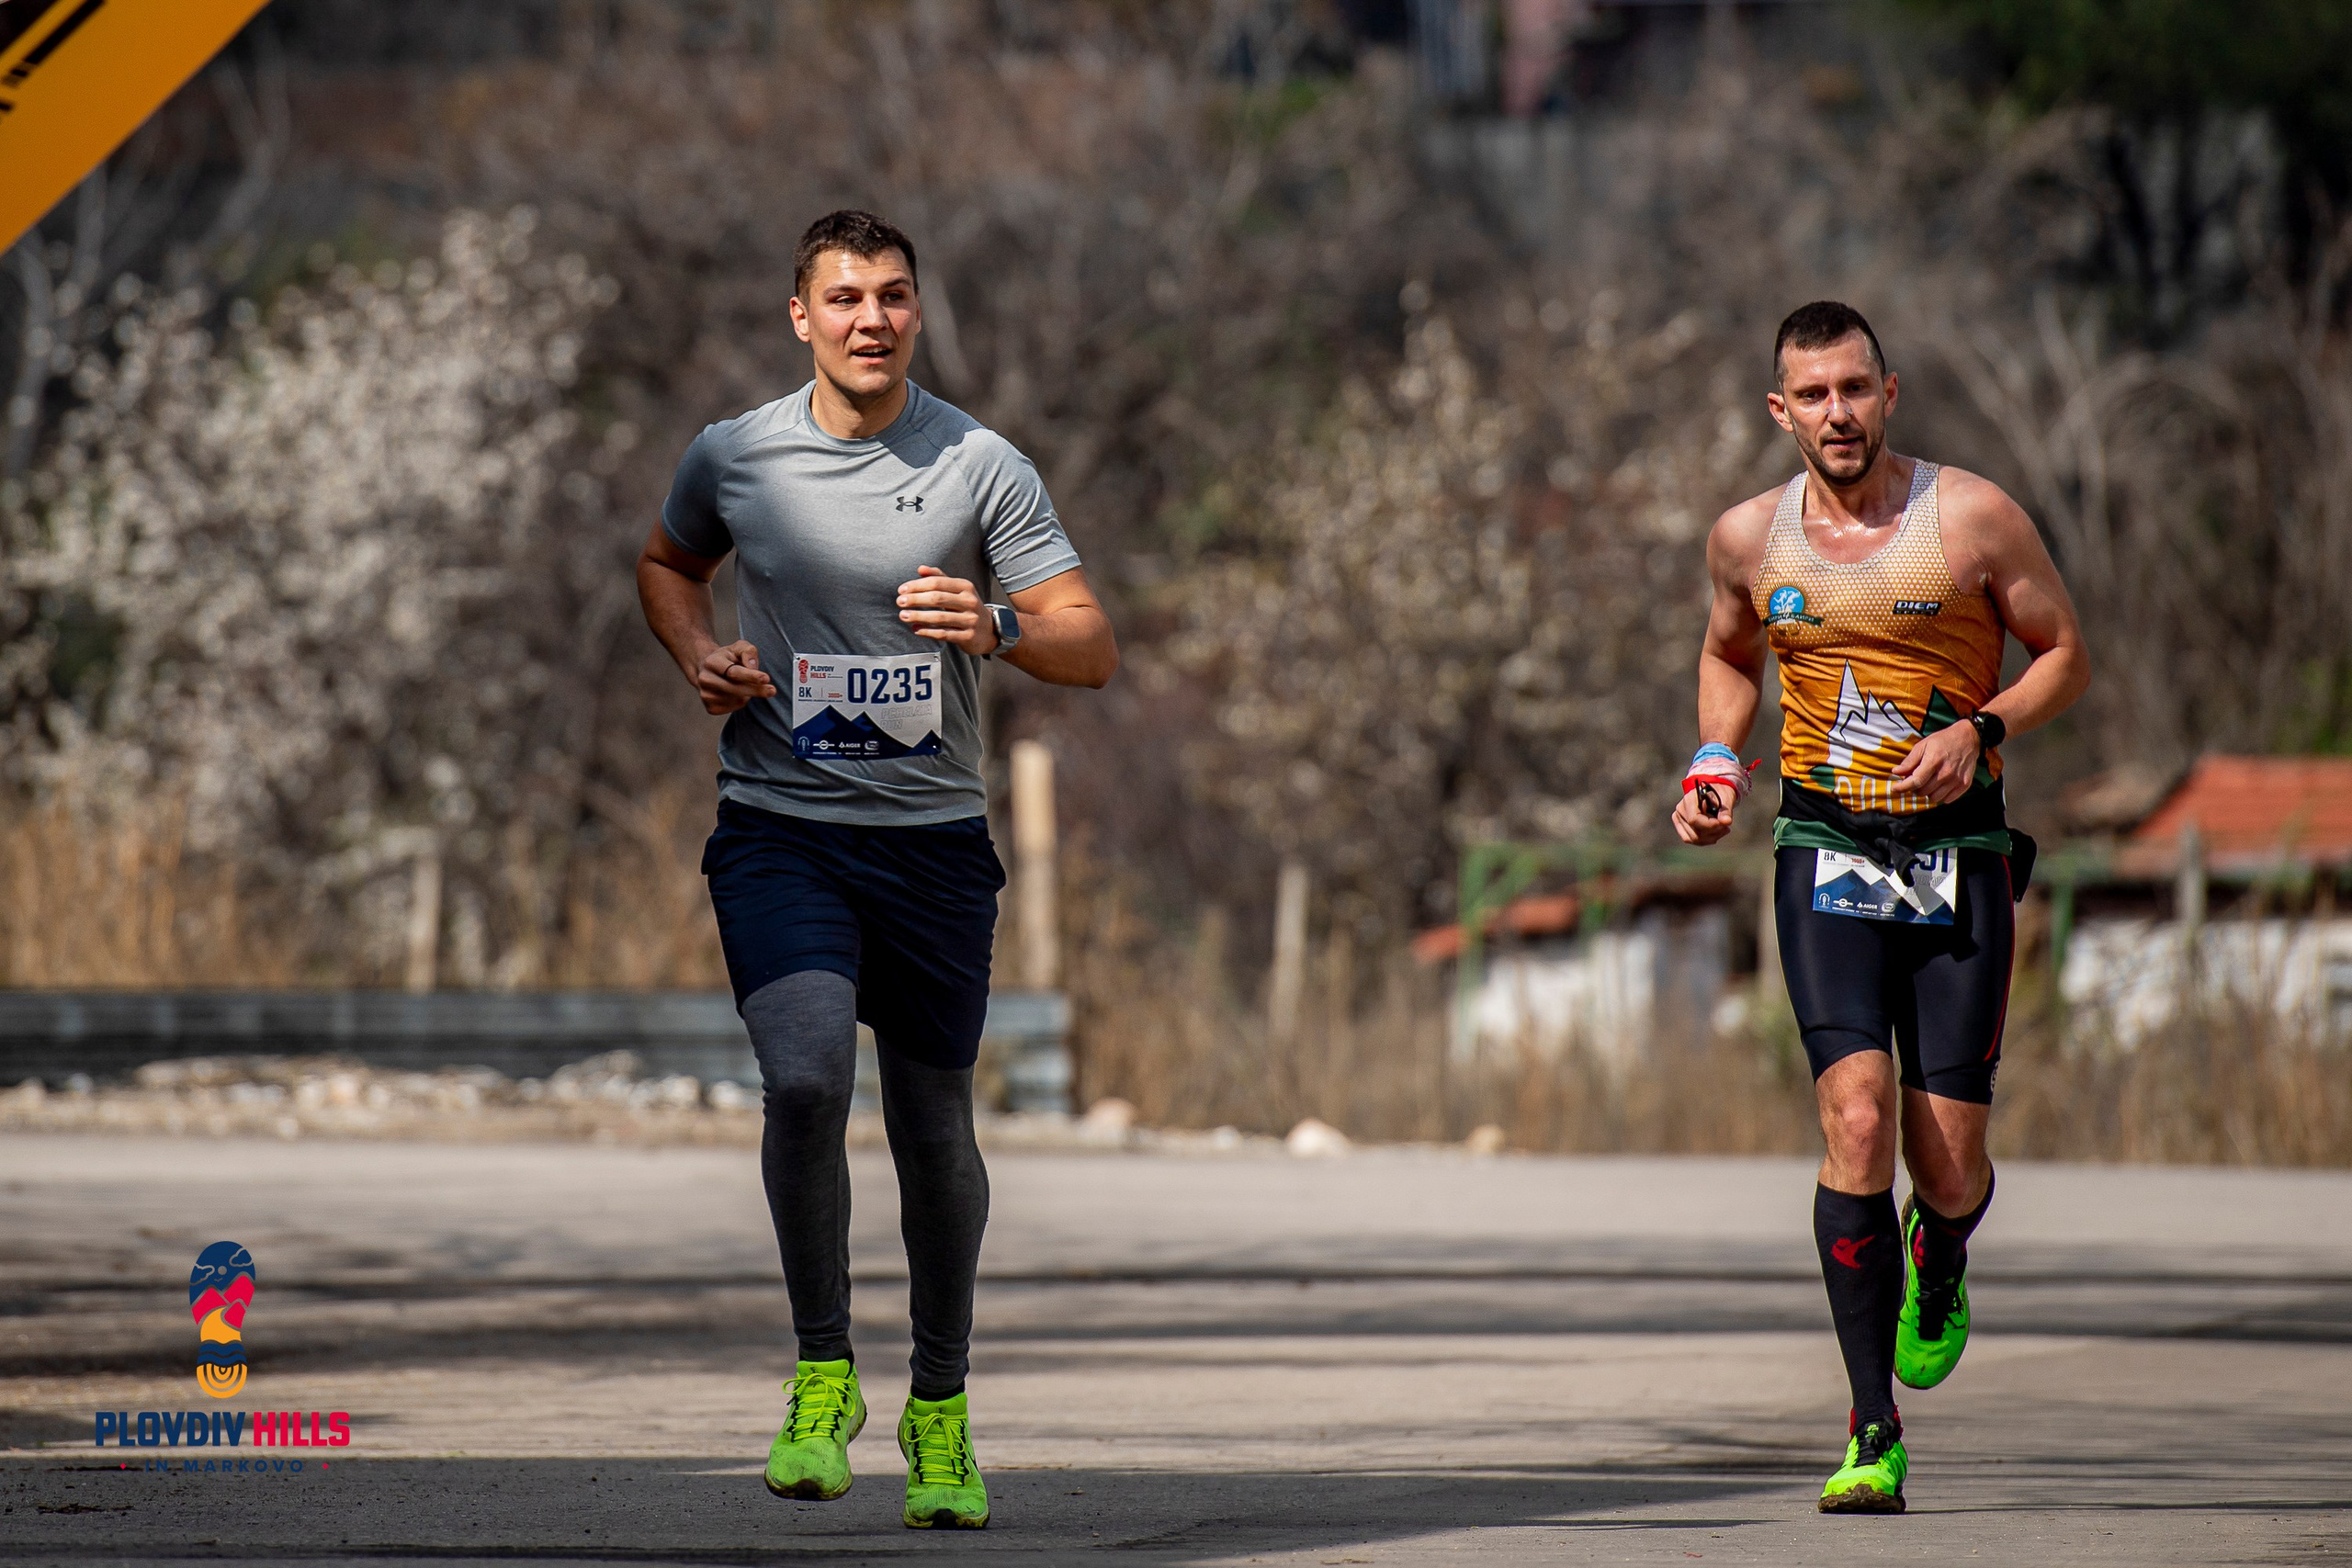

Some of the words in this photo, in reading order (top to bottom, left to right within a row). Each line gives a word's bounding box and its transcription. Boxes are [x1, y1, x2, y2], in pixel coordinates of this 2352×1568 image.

[1895, 601, 1939, 610] DIEM
[847, 665, 933, 705] 0235
[798, 687, 812, 698] 8K
[1824, 852, 1837, 862] 8K
